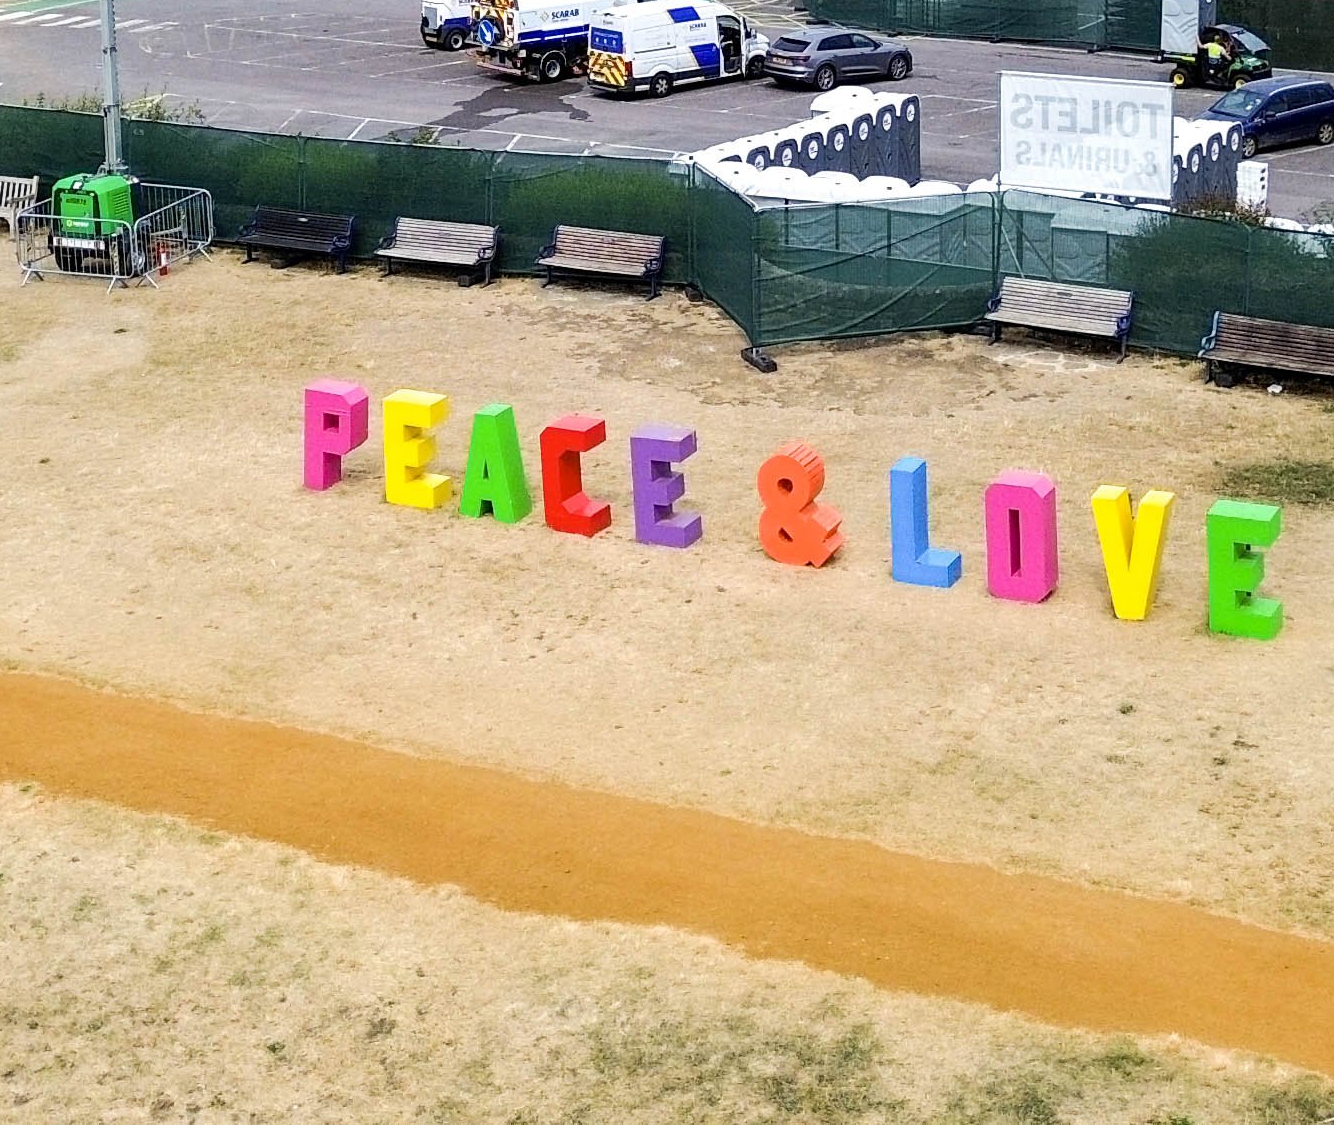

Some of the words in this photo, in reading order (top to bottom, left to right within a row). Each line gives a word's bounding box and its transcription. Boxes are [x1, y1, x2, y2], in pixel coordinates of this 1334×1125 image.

[551, 8, 580, 20] SCARAB
[304, 378, 704, 548] PEACE
[757, 440, 845, 569] &
[889, 456, 1284, 641] LOVE
